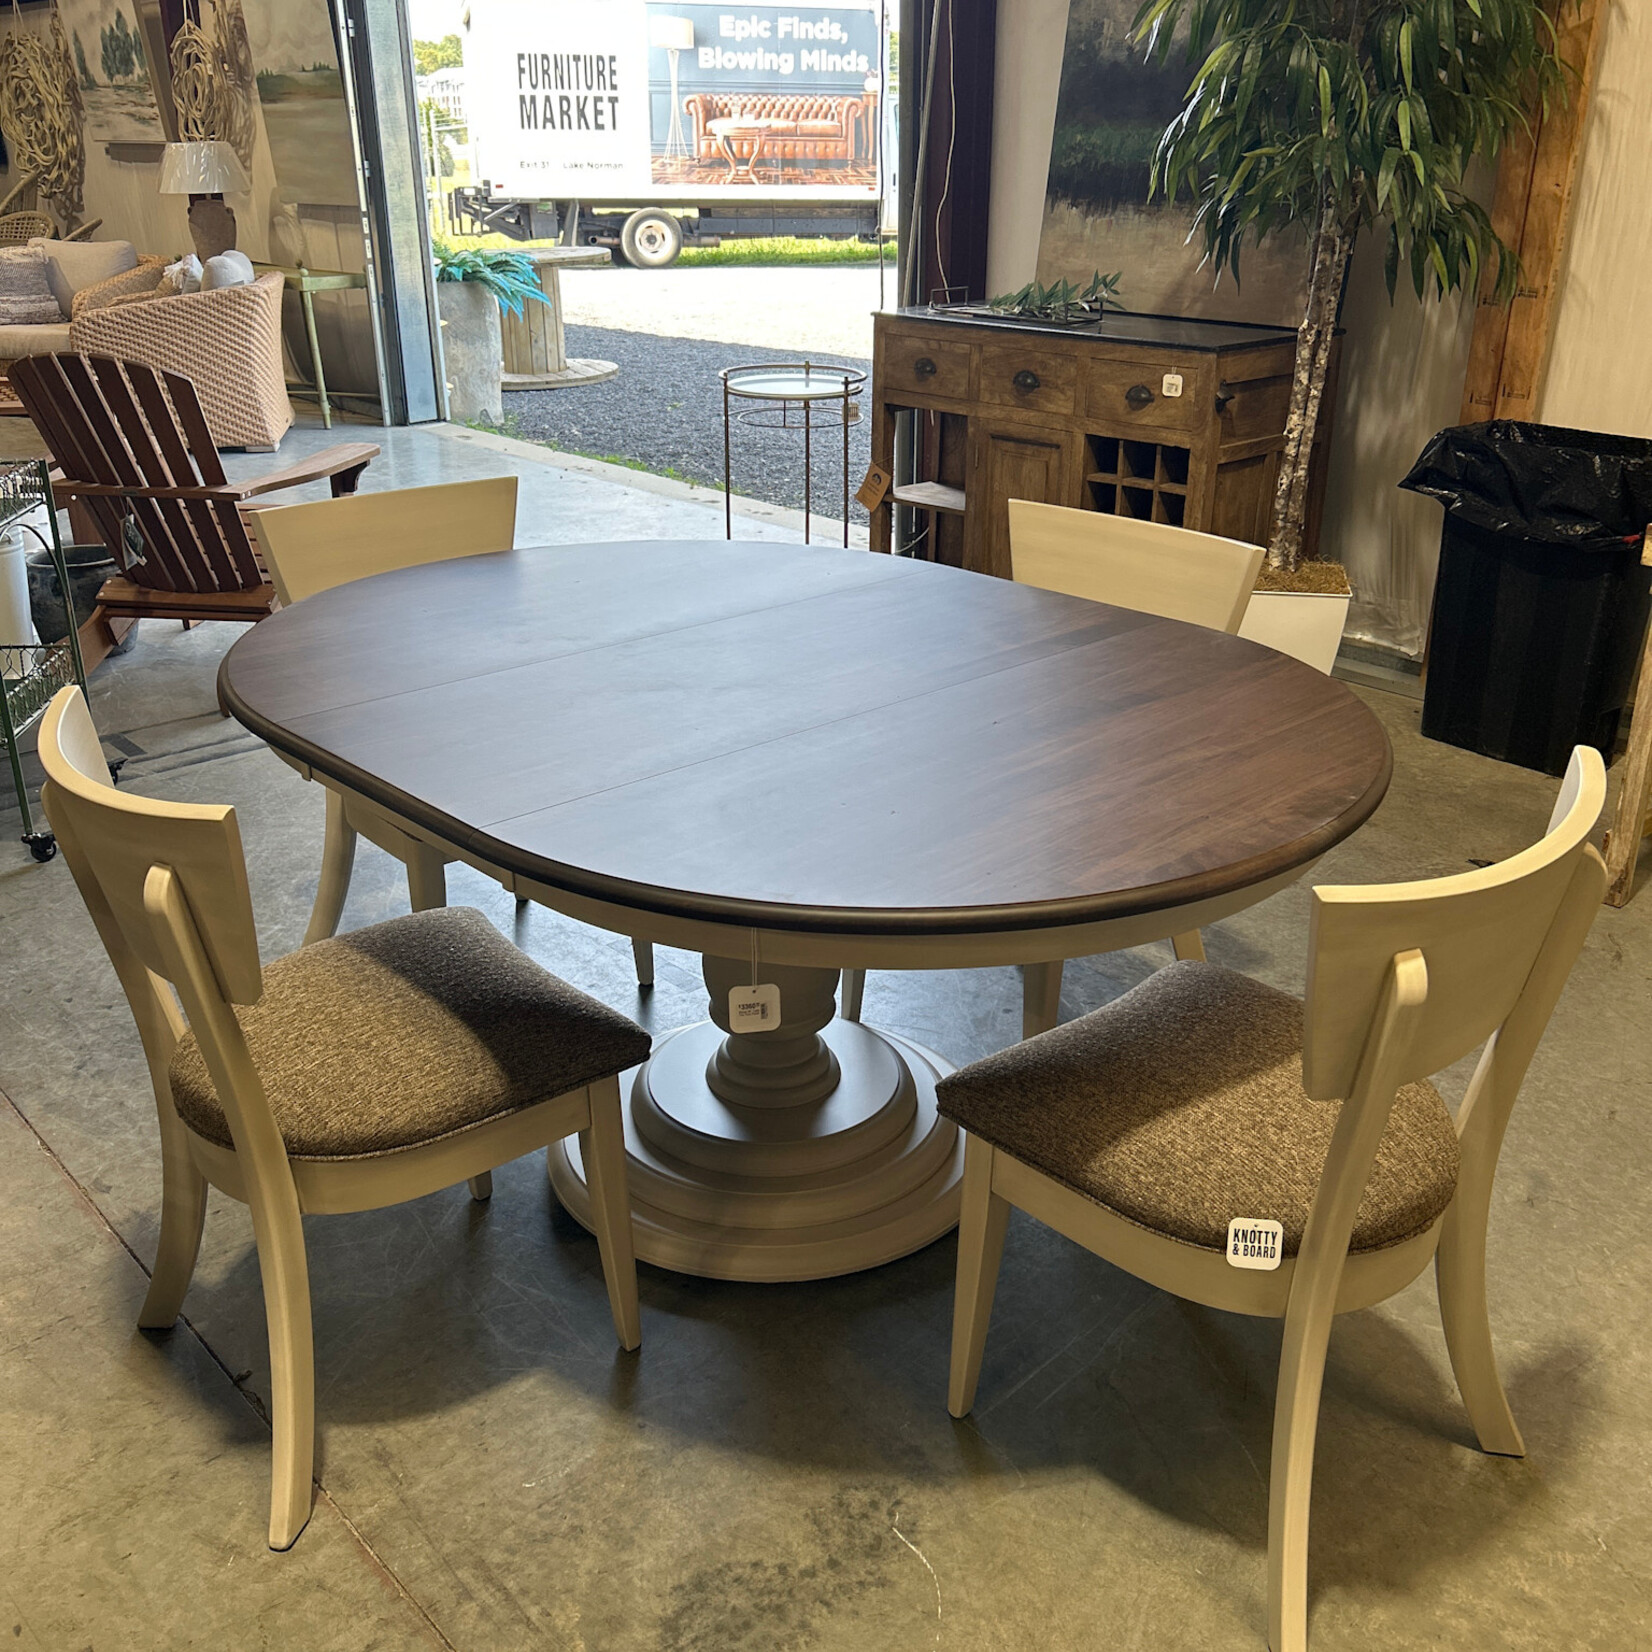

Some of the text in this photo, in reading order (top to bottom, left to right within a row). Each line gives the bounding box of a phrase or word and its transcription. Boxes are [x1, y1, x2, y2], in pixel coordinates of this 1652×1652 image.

[719, 15, 848, 44] Epic Finds,
[698, 46, 869, 74] Blowing Minds
[517, 52, 618, 91] FURNITURE
[519, 94, 619, 131] MARKET
[519, 160, 538, 169] Exit
[562, 161, 624, 170] Lake Norman
[1233, 1228, 1278, 1245] KNOTTY
[1232, 1243, 1276, 1259] & BOARD
